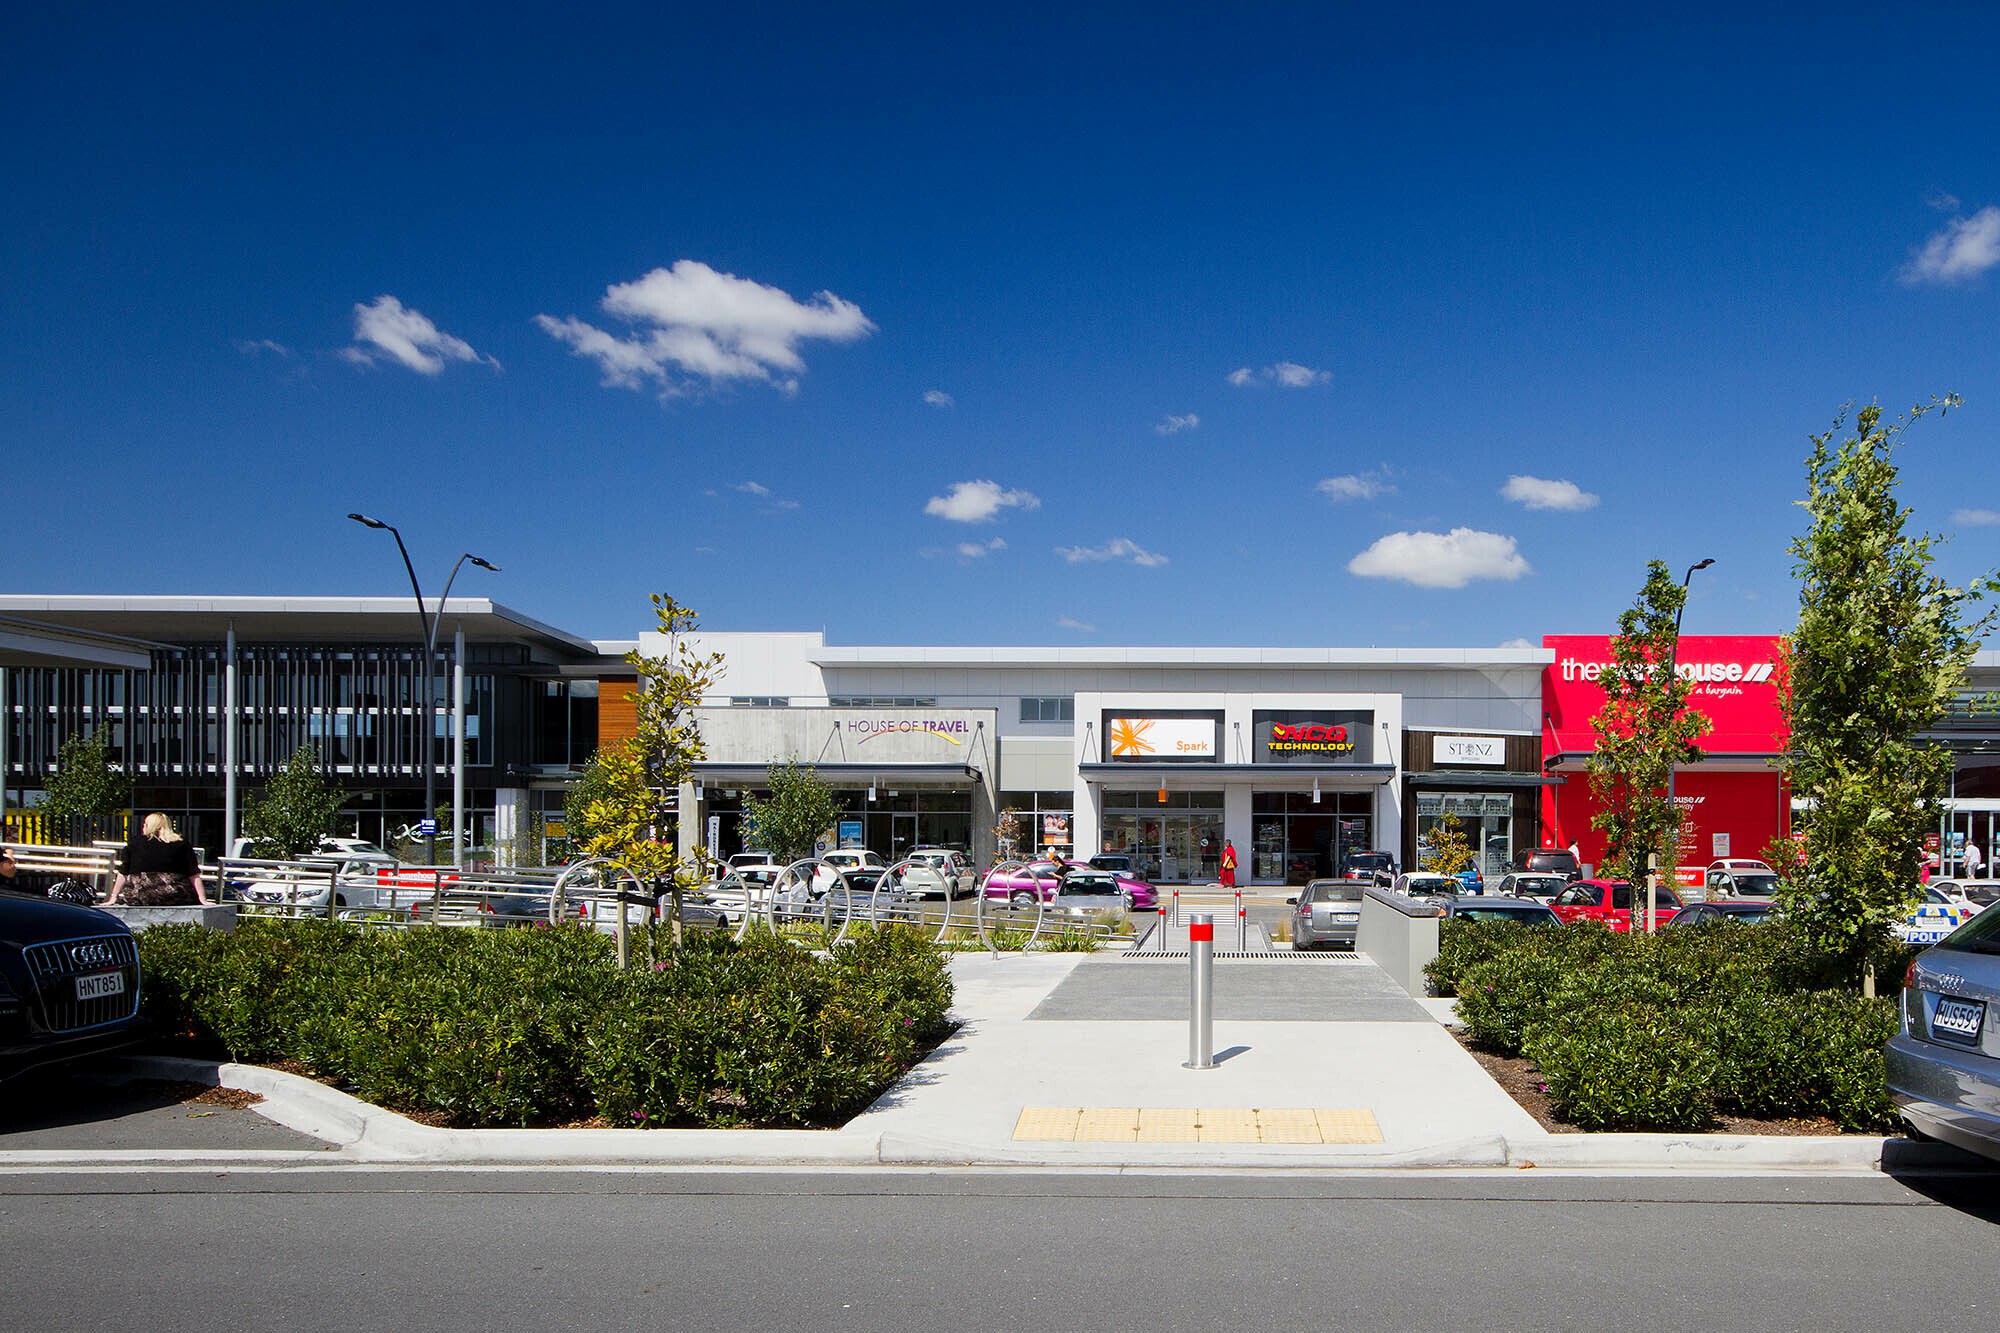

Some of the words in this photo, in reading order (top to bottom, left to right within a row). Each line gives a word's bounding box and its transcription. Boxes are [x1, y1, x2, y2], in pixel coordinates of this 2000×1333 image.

[1695, 686, 1703, 695] a
[1705, 684, 1743, 698] bargain
[848, 720, 895, 733] HOUSE
[899, 720, 919, 733] OF
[922, 720, 969, 733] TRAVEL
[1176, 739, 1208, 753] Spark
[1267, 742, 1354, 751] TECHNOLOGY
[79, 975, 122, 997] HNT851
[1936, 1001, 1981, 1031] HUS593
